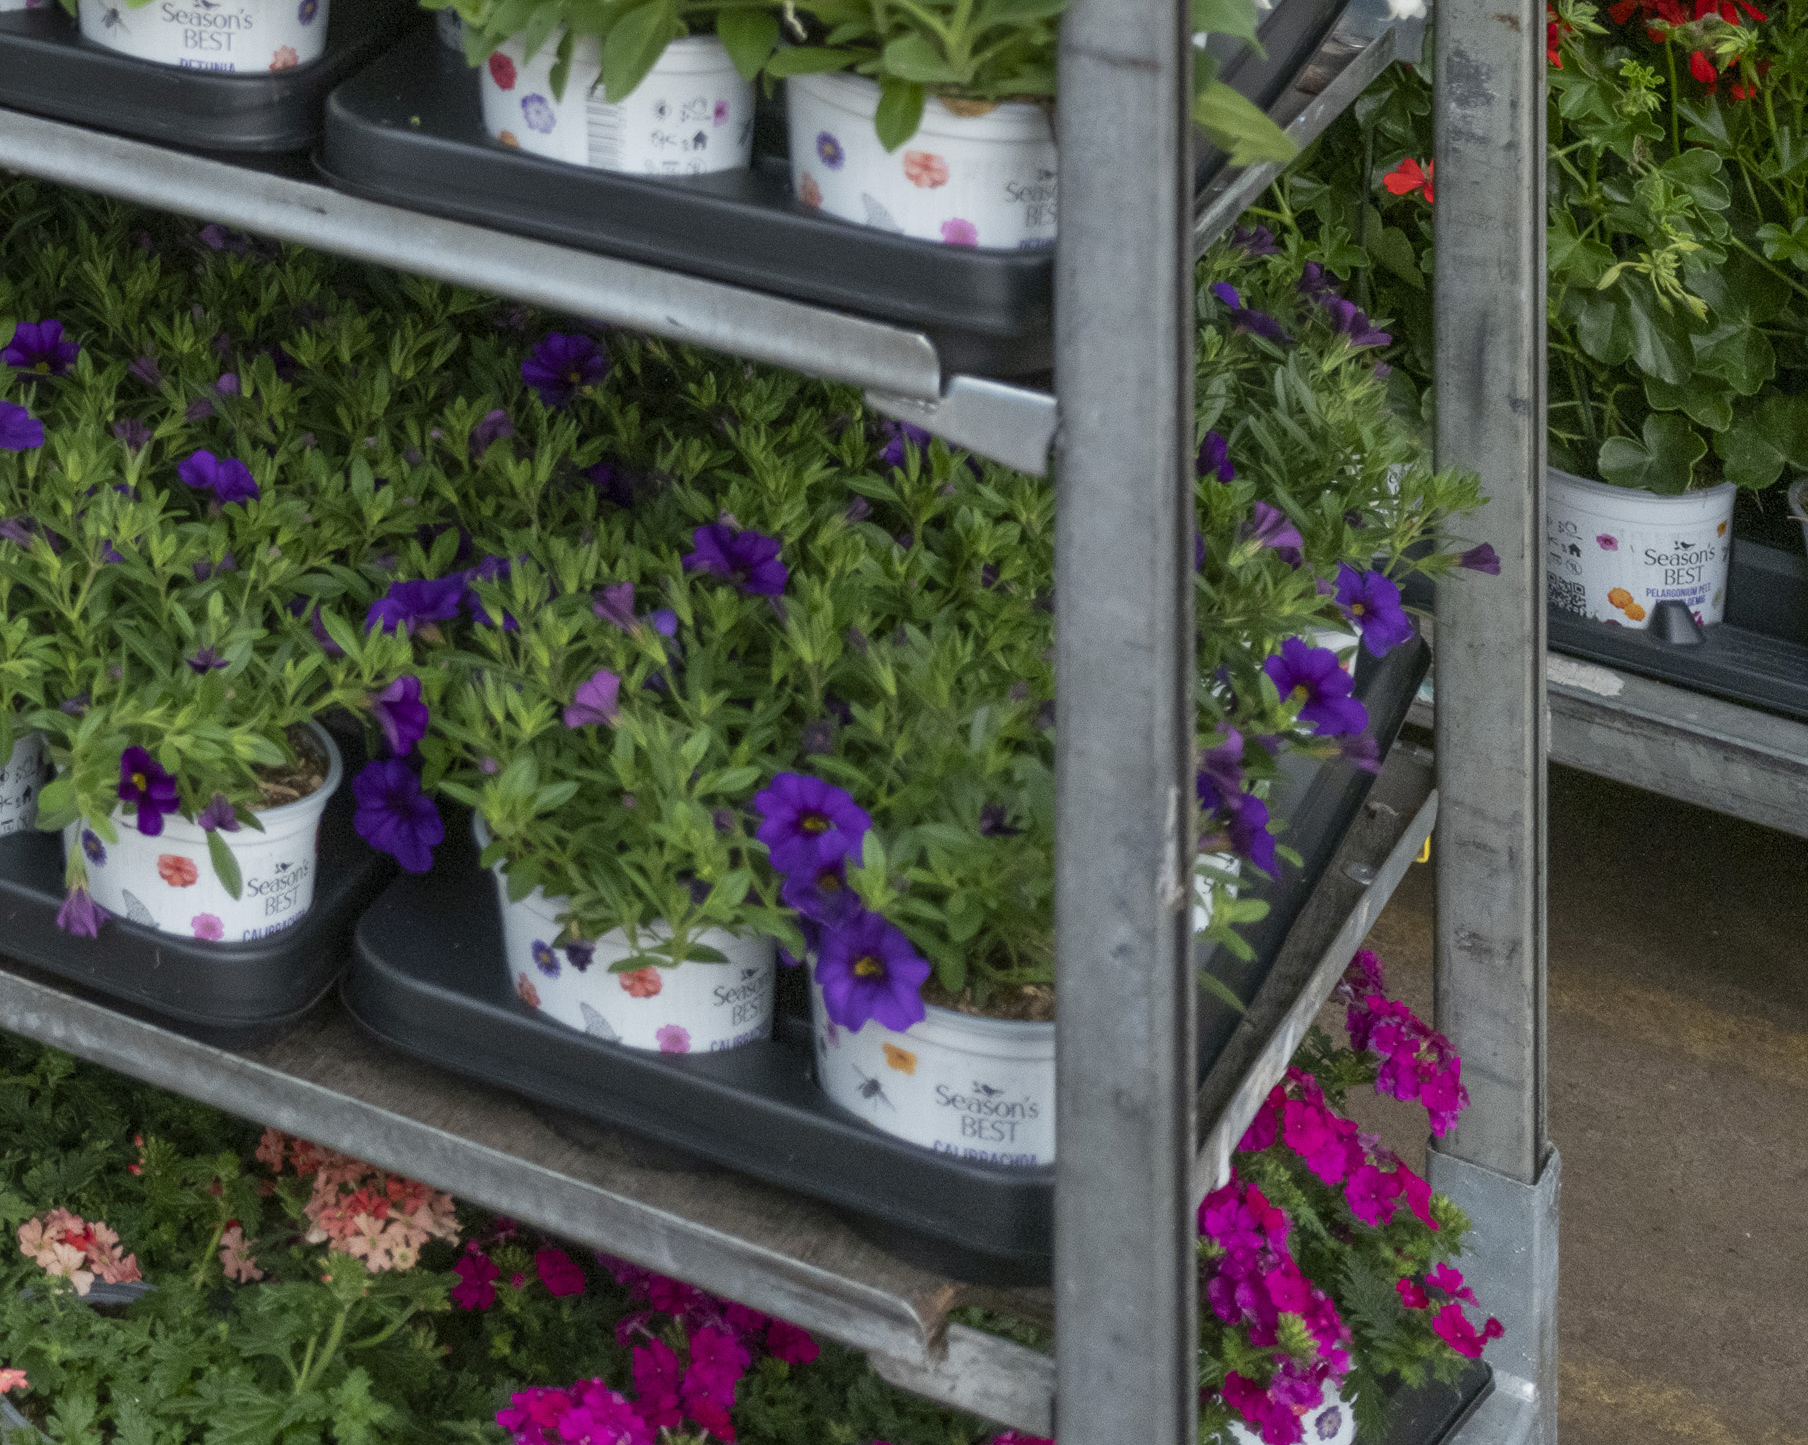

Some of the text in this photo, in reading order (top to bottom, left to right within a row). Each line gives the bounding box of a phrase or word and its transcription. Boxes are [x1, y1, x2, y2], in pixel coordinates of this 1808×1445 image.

[162, 2, 254, 30] Season's
[183, 28, 234, 52] BEST
[1644, 548, 1715, 566] Season's
[1664, 565, 1703, 585] BEST
[1645, 586, 1695, 598] PELARGONIUM
[247, 860, 309, 897] Season's
[265, 890, 299, 916] BEST
[935, 1084, 1037, 1120] Season's
[960, 1116, 1018, 1143] BEST
